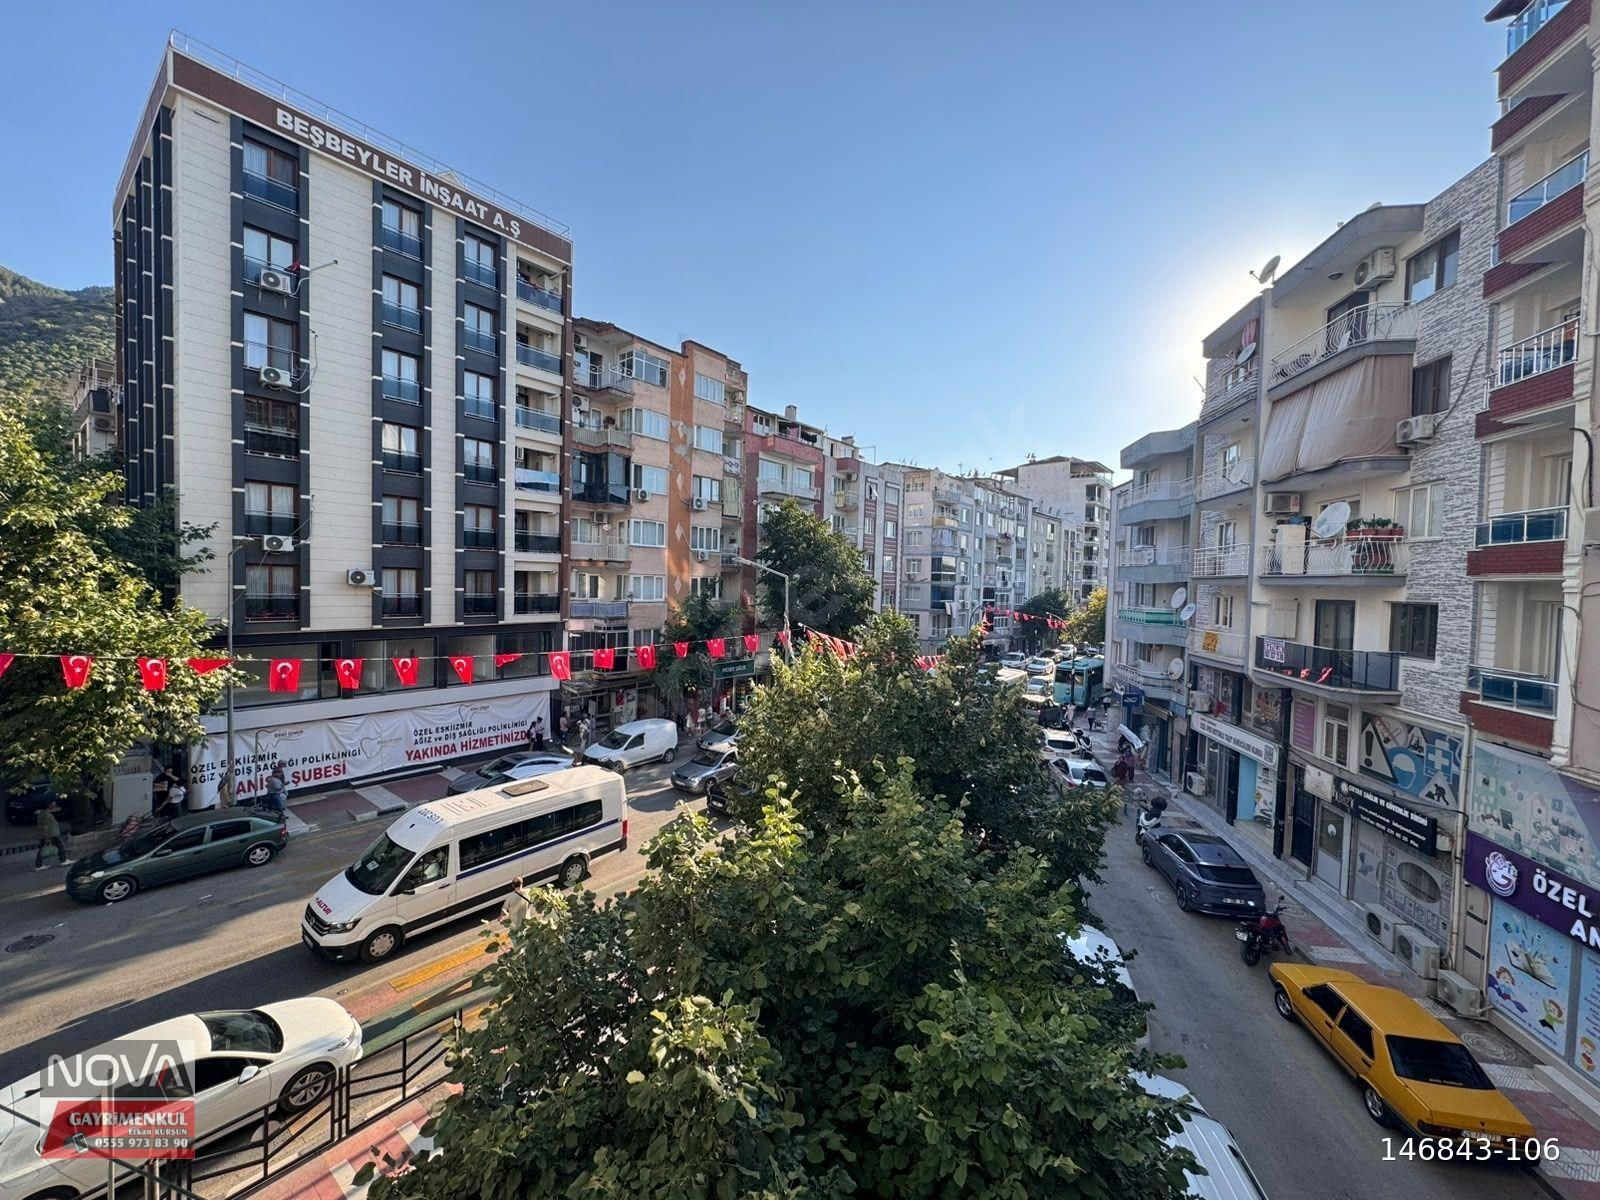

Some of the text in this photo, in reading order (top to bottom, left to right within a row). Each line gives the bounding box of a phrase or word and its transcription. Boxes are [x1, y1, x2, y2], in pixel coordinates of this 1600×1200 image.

[276, 108, 521, 238] BEŞBEYLER İNŞAAT A.Ş
[405, 729, 531, 761] YAKINDA HİZMETİNİZD
[413, 727, 433, 737] ÖZEL
[413, 735, 432, 746] AĞIZ
[444, 731, 457, 741] DİŞ
[458, 726, 487, 738] SAĞLIĞI
[190, 752, 278, 774] ÖZEL EKİİZMİR
[191, 772, 216, 785] AĞIZ
[235, 765, 252, 776] DİŞ
[256, 757, 298, 772] SAĞĞI
[291, 761, 347, 788] ŞUBESİ
[1532, 868, 1592, 918] ÖZEL
